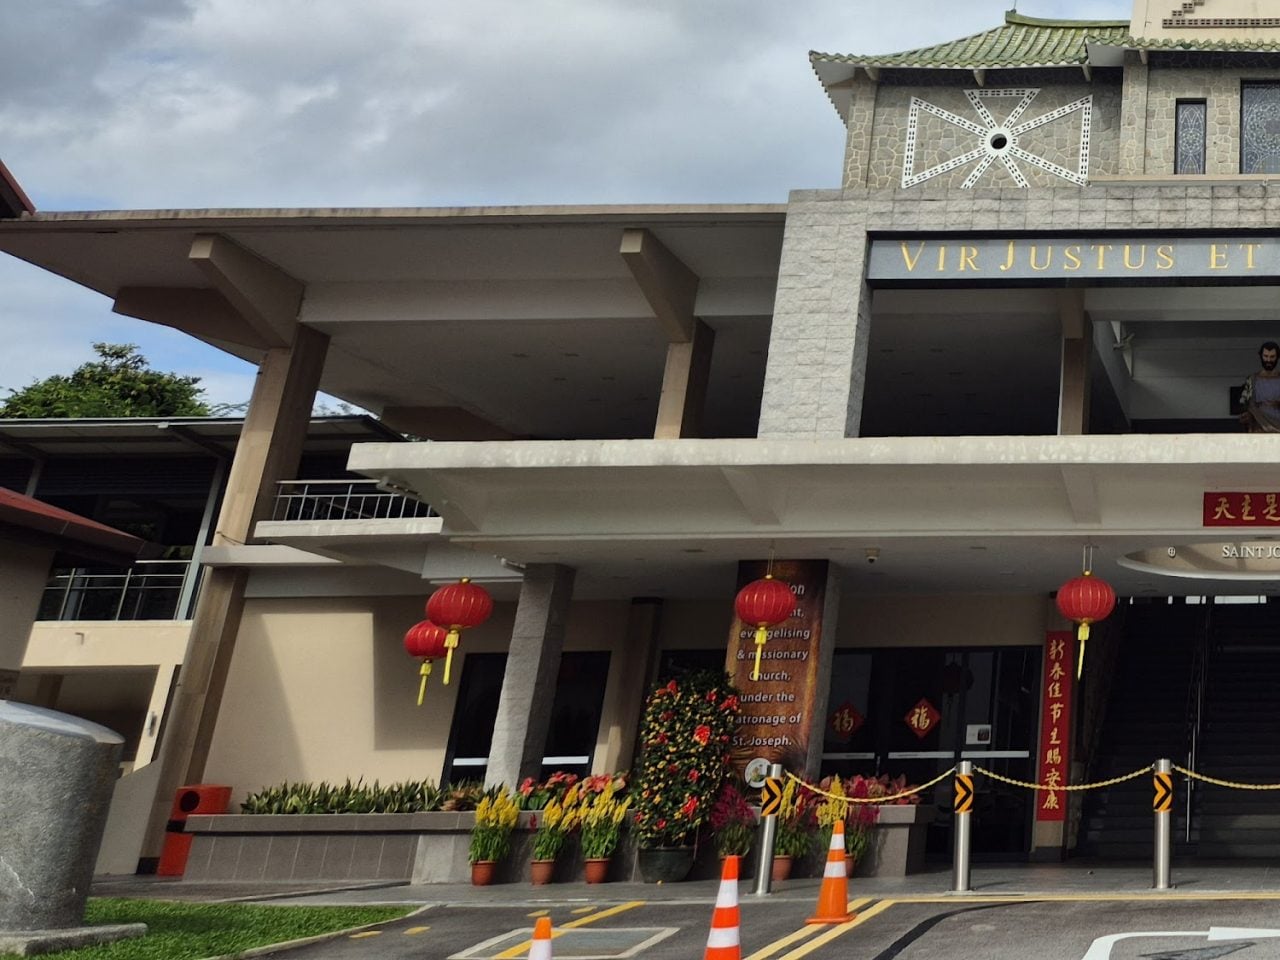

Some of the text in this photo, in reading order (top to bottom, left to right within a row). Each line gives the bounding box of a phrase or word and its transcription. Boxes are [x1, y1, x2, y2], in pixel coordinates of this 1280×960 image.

[901, 241, 981, 272] VIR
[999, 240, 1175, 271] JUSTUS
[1208, 243, 1262, 269] ET
[1222, 545, 1265, 559] SAINT
[737, 649, 809, 661] & mssionary
[740, 691, 795, 702] under the
[734, 712, 802, 726] atronage of
[910, 705, 931, 730] 福
[732, 735, 792, 748] St. Joseph.
